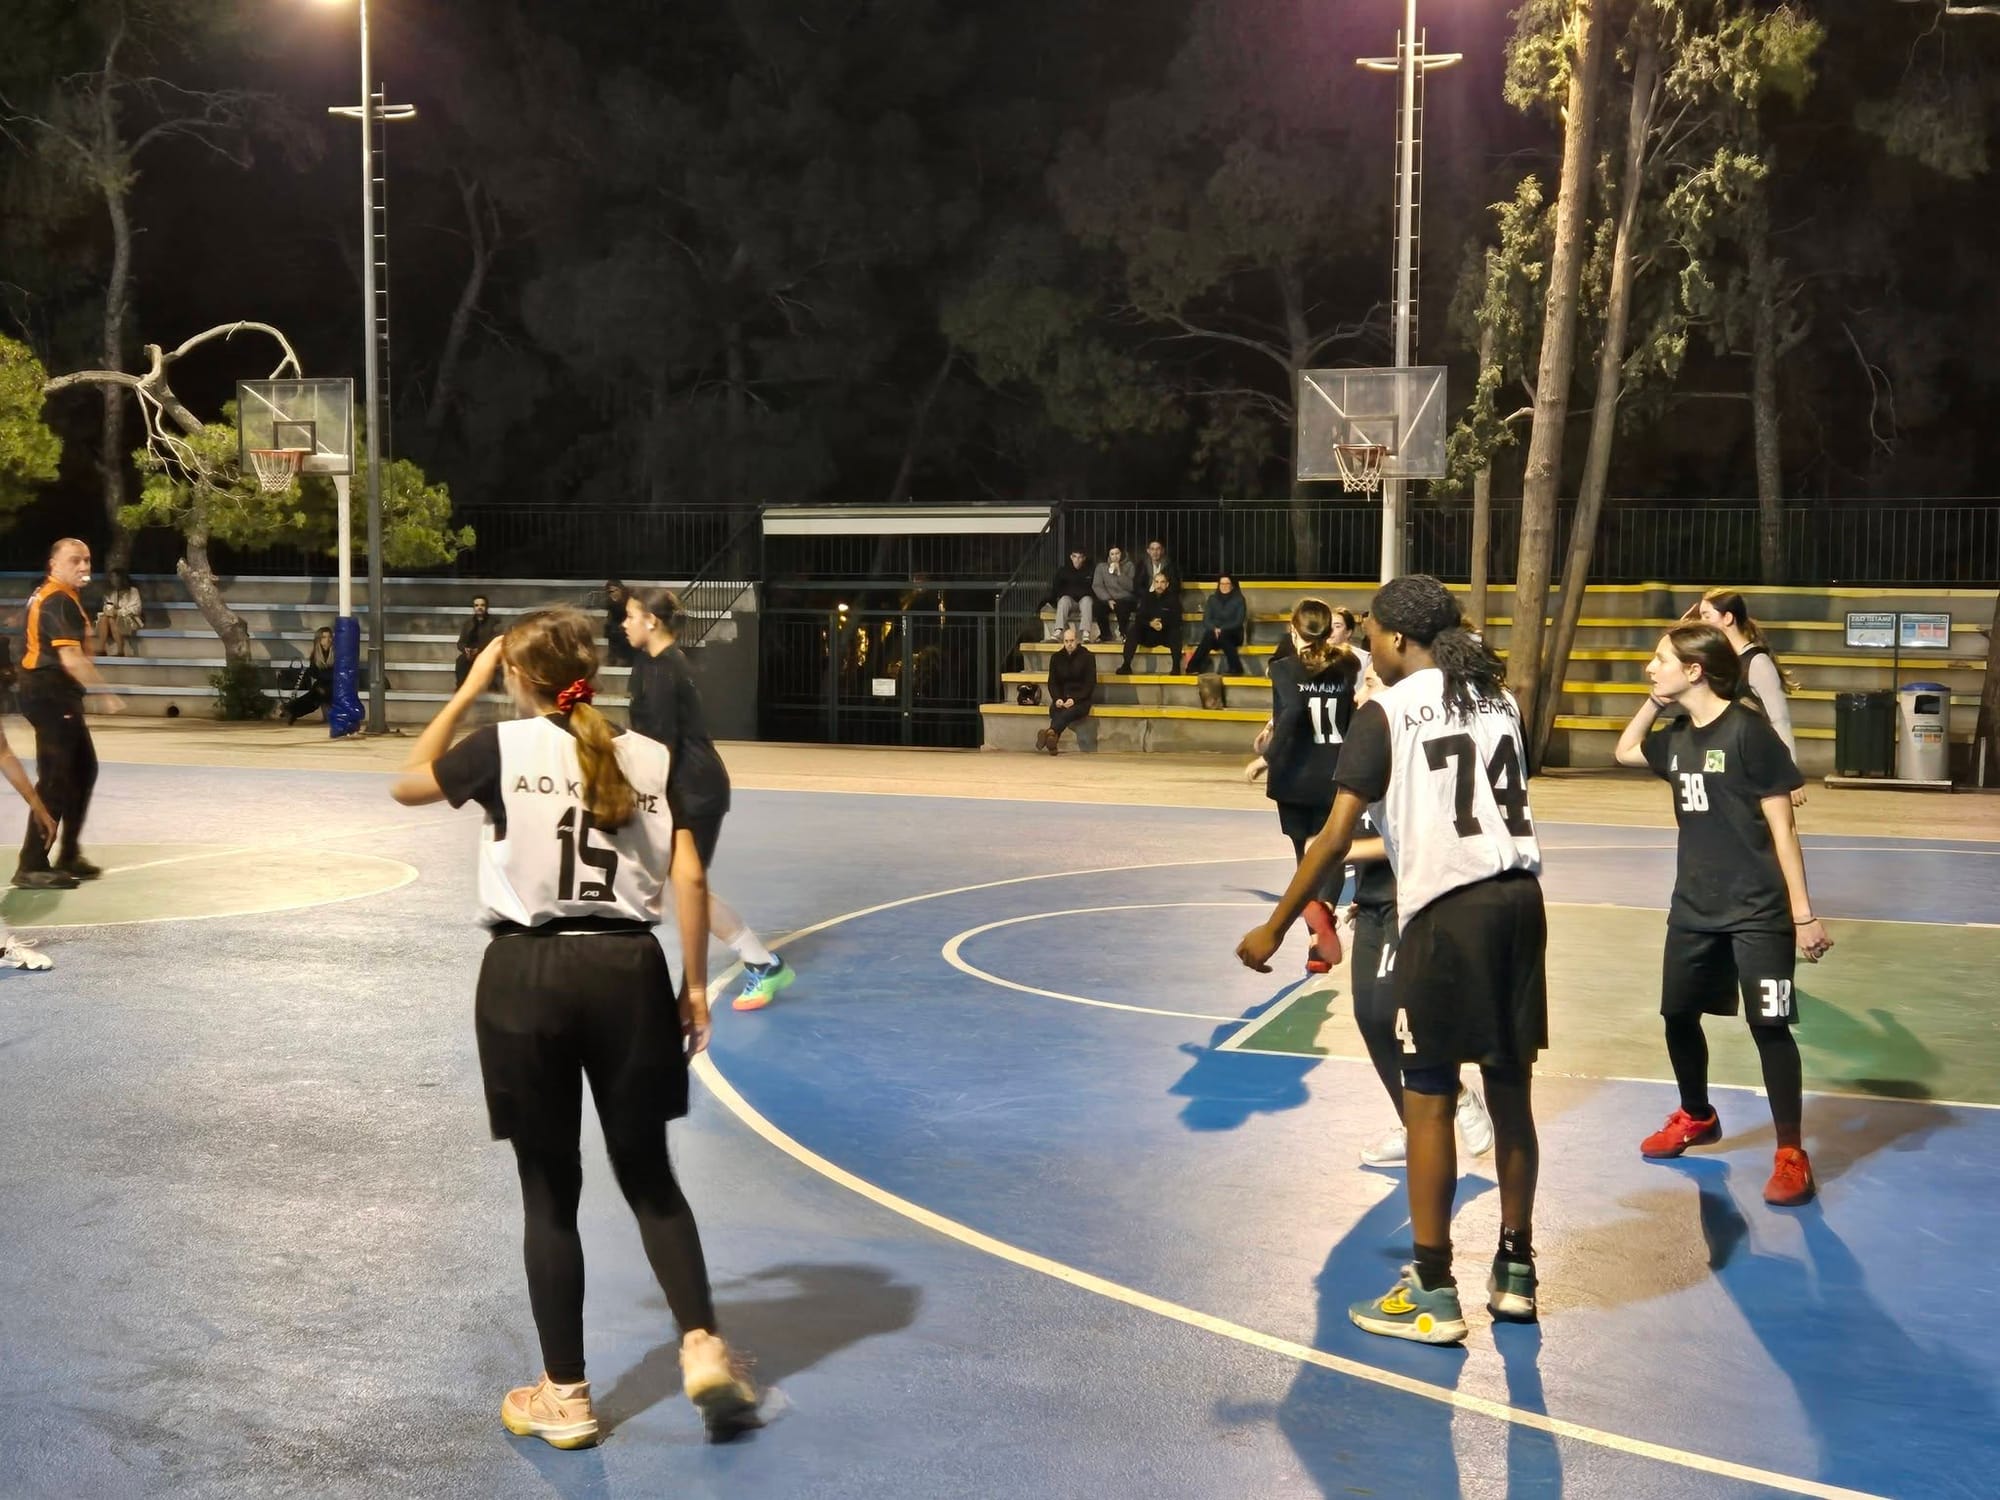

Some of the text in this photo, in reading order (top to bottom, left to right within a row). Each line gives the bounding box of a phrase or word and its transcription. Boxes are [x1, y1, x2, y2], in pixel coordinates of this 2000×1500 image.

[1308, 697, 1343, 743] 11
[1422, 733, 1533, 838] 74
[1679, 773, 1709, 811] 38
[556, 806, 618, 902] 15
[1760, 979, 1791, 1017] 38
